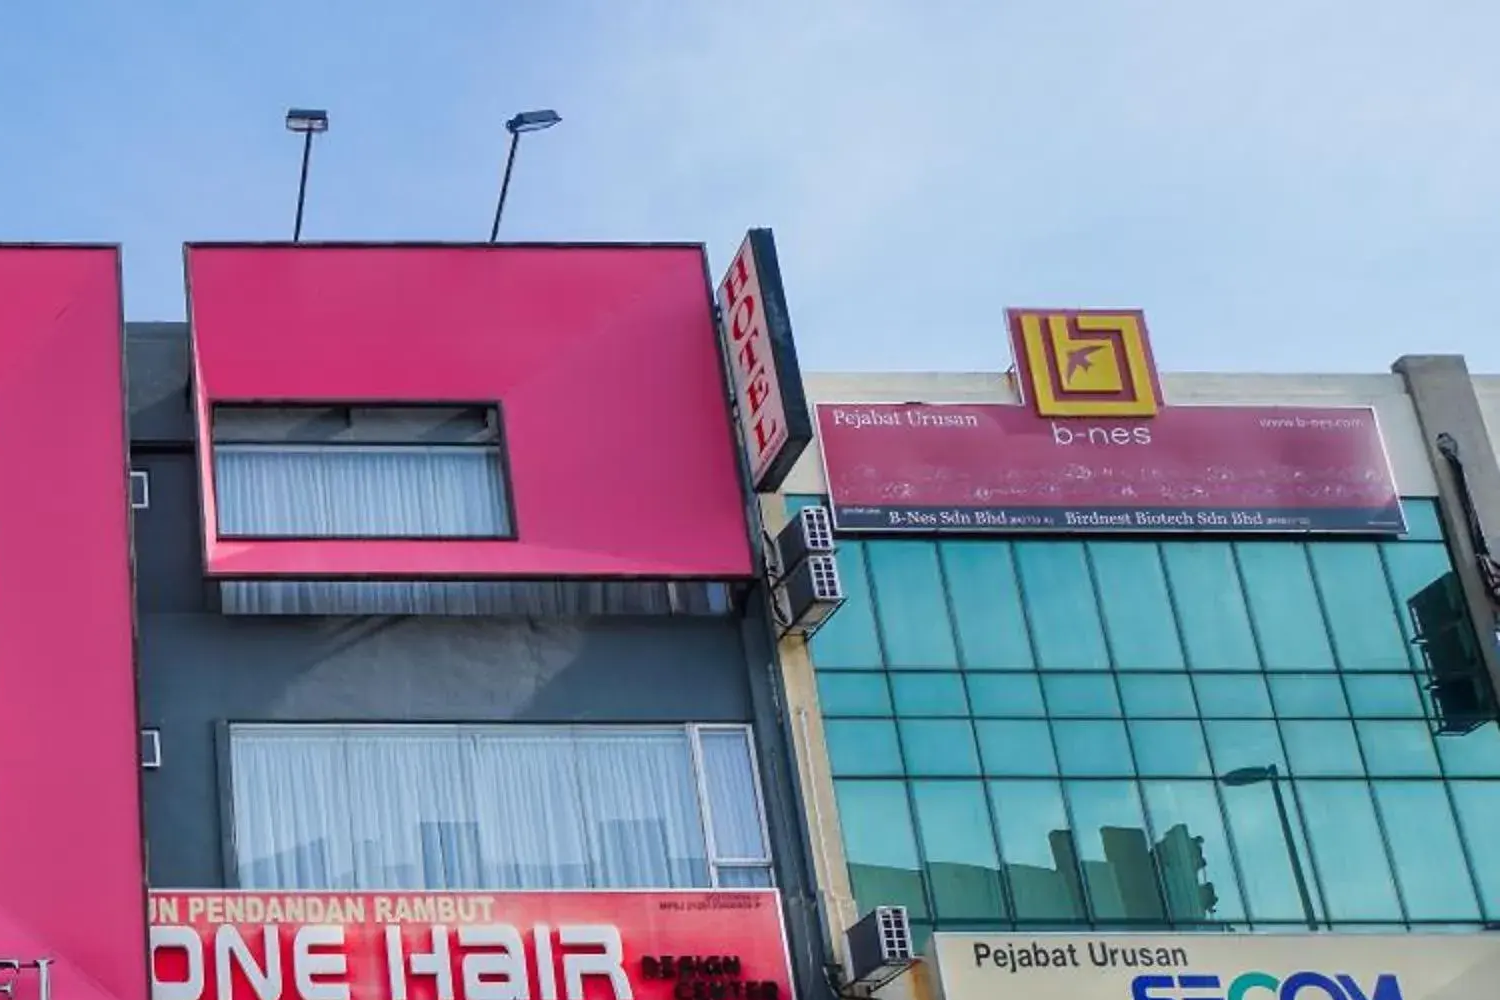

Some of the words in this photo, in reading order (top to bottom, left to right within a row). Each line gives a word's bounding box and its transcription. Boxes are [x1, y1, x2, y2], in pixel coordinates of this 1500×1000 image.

[724, 254, 777, 457] HOTEL
[833, 410, 900, 428] Pejabat
[907, 411, 978, 427] Urusan
[1052, 422, 1151, 445] b-nes
[888, 511, 937, 525] B-Nes
[939, 511, 971, 525] Sdn
[975, 511, 1006, 525] Bhd
[1065, 511, 1131, 526] Birdnest
[1136, 511, 1193, 526] Biotech
[1197, 511, 1228, 526] Sdn
[1231, 511, 1263, 526] Bhd
[188, 896, 365, 923] PENDANDAN
[375, 896, 496, 923] RAMBUT
[641, 956, 741, 979] DESIGN
[973, 942, 1077, 973] Pejabat
[1088, 942, 1188, 968] Urusan
